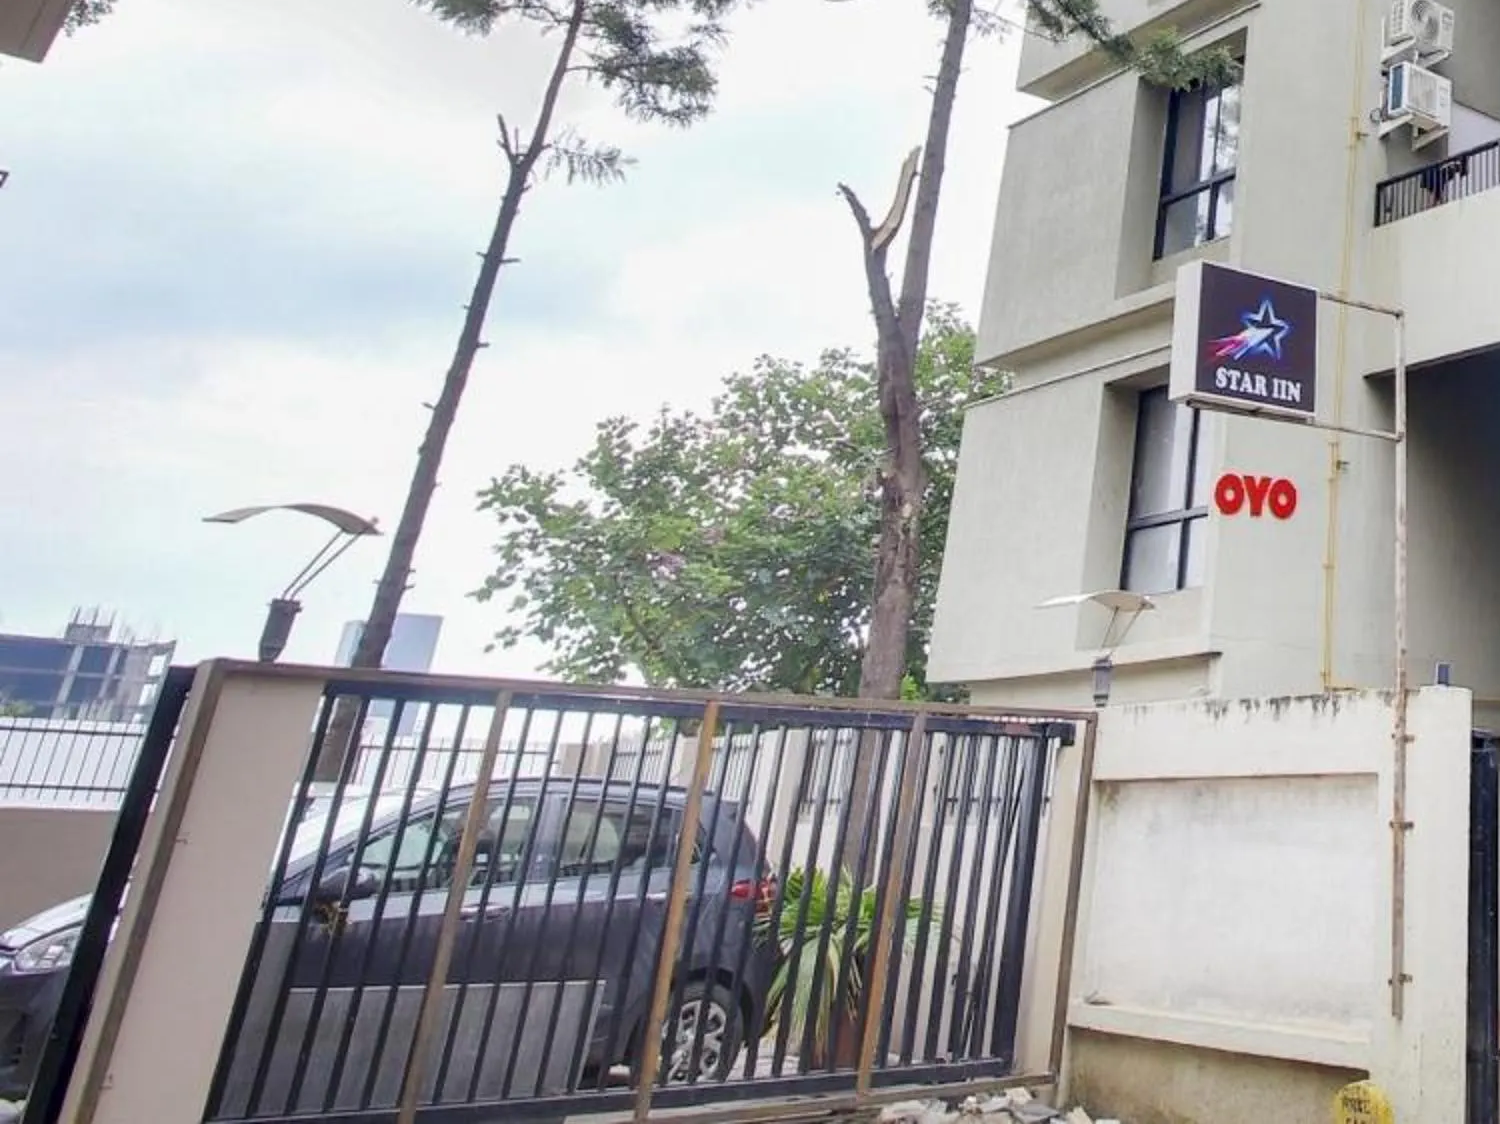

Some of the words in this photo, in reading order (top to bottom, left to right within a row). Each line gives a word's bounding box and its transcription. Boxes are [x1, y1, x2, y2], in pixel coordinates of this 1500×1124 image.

[1215, 366, 1268, 397] STAR
[1272, 380, 1302, 403] IIN
[1214, 474, 1297, 520] OYO
